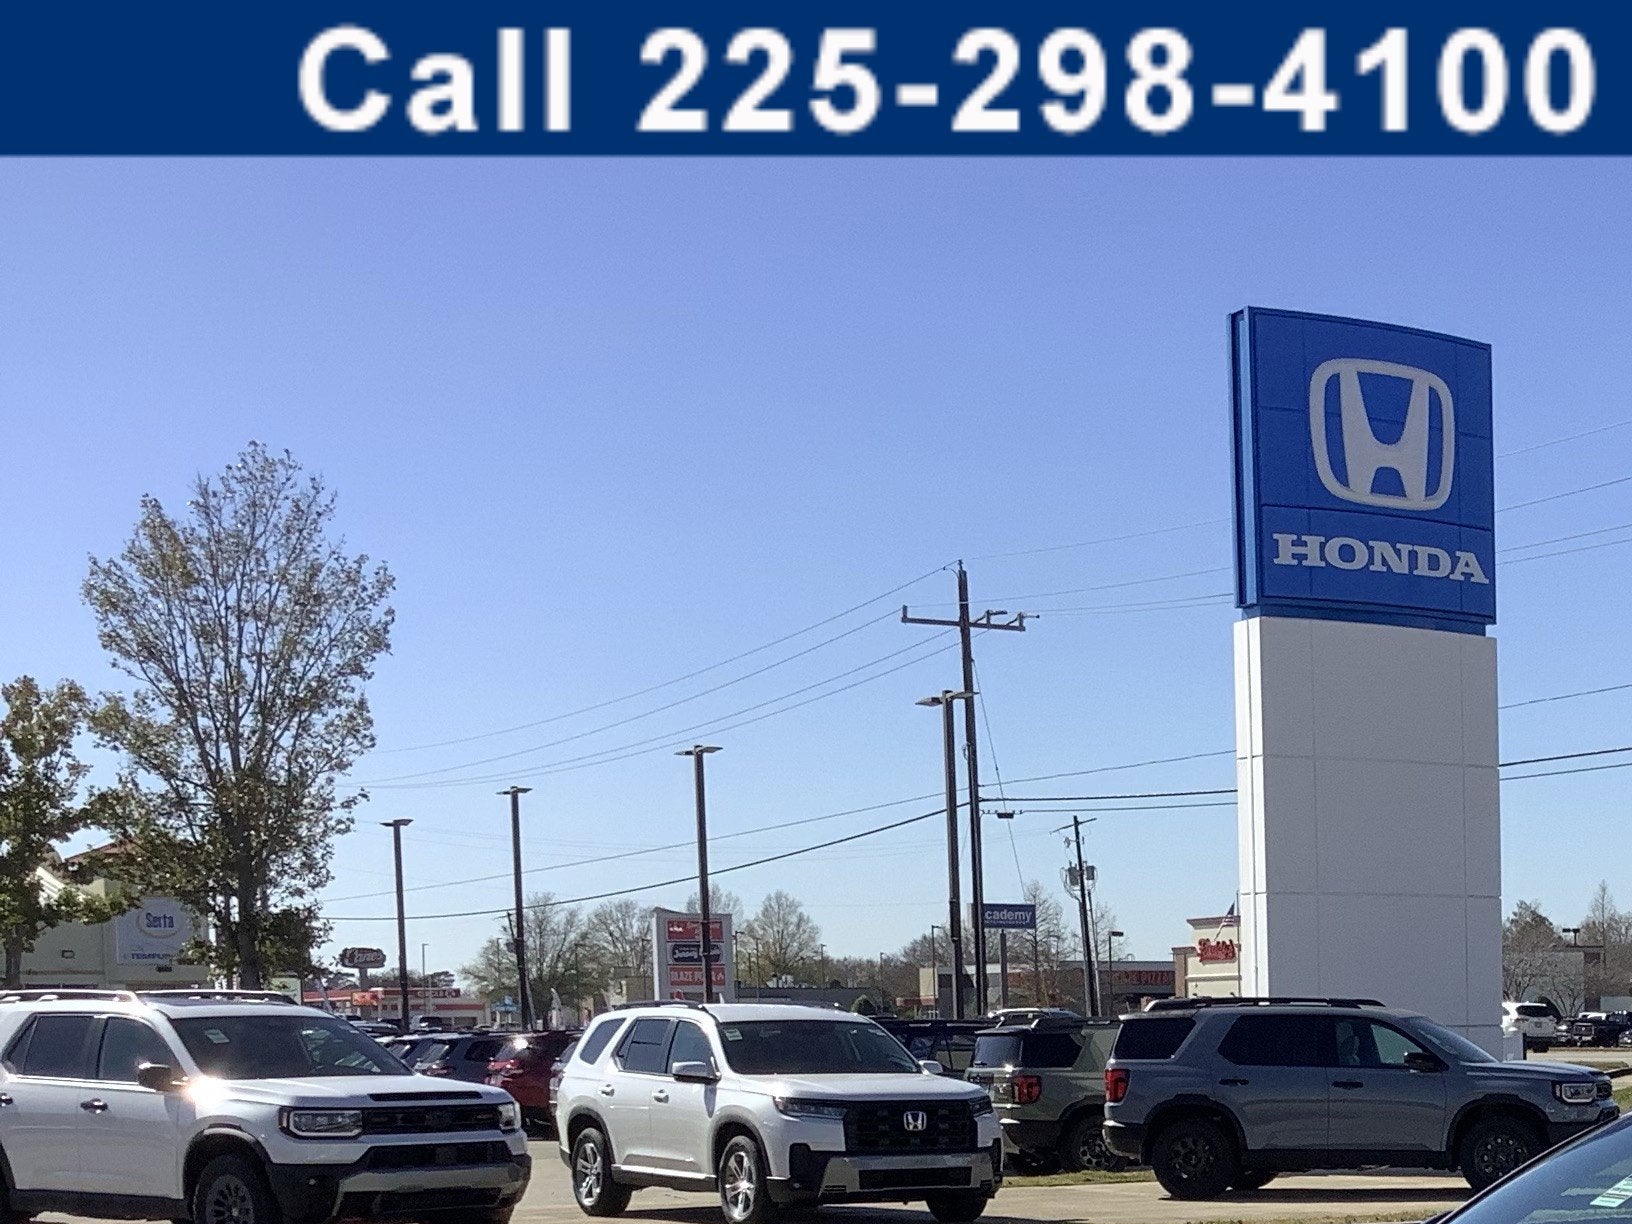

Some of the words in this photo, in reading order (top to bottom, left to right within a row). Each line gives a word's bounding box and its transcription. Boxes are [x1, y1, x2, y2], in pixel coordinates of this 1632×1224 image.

[1273, 533, 1489, 584] HONDA
[145, 912, 175, 928] Serta
[984, 908, 1032, 924] cademy
